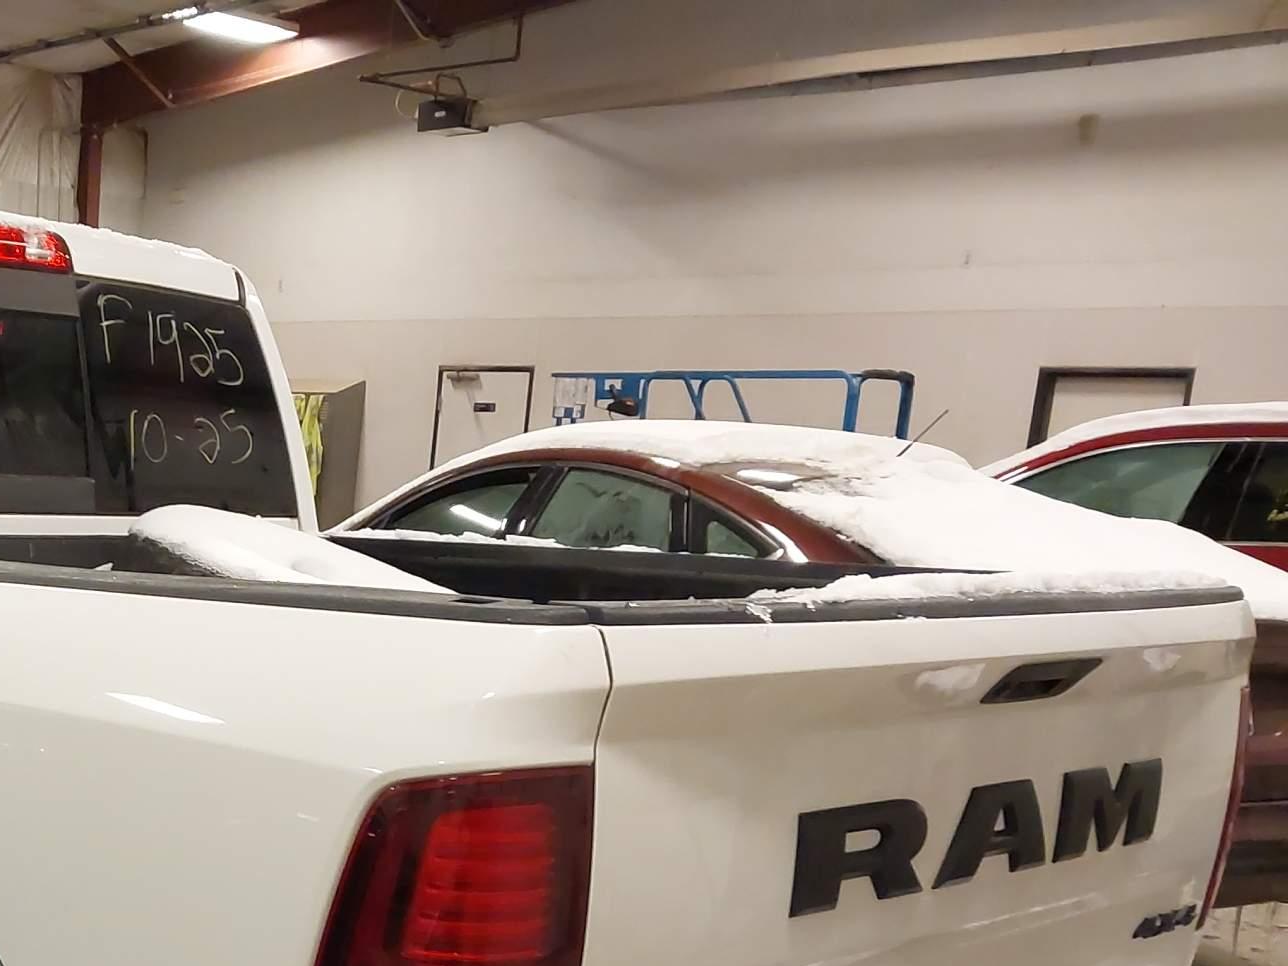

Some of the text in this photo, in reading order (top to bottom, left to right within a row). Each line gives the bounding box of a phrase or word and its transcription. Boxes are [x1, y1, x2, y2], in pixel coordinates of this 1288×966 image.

[97, 293, 245, 386] F 1925
[129, 408, 254, 471] 10-25
[788, 757, 1163, 918] RAM
